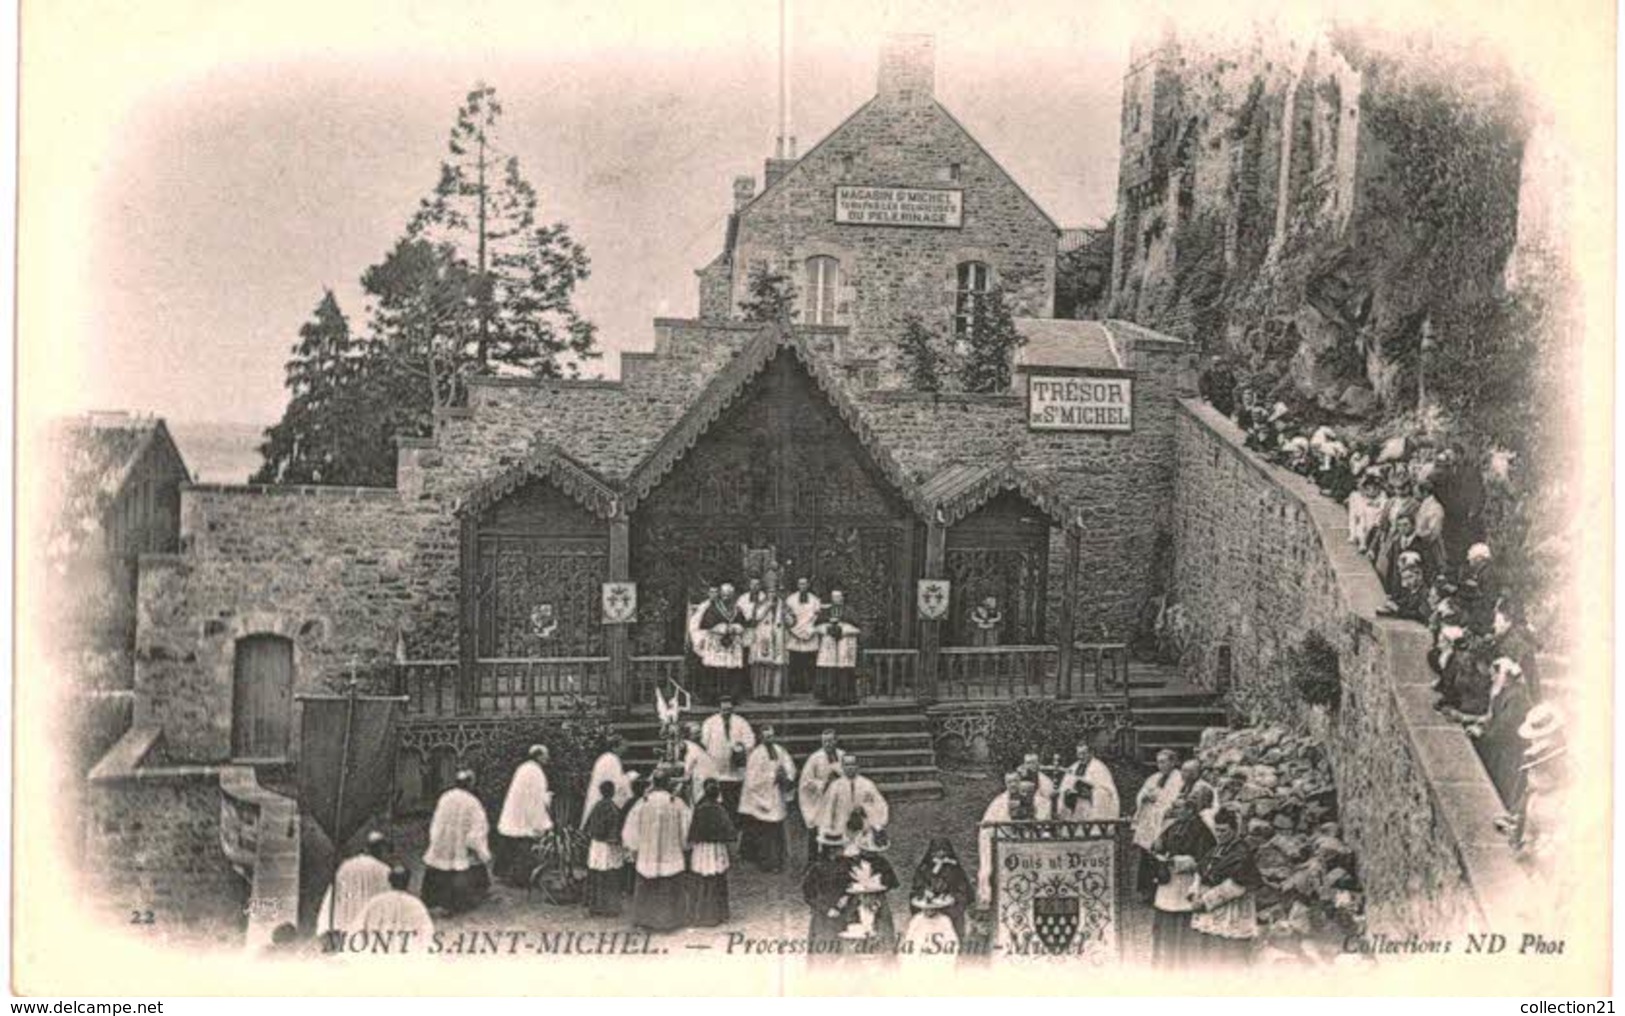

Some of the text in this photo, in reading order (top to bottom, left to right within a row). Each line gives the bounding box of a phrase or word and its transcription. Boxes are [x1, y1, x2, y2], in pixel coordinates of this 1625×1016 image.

[840, 189, 893, 201] MAGASIN
[907, 192, 952, 204] MICHEL
[847, 211, 864, 220] DU
[1033, 379, 1121, 403] TRÉSOR
[1060, 406, 1128, 425] MICHEL
